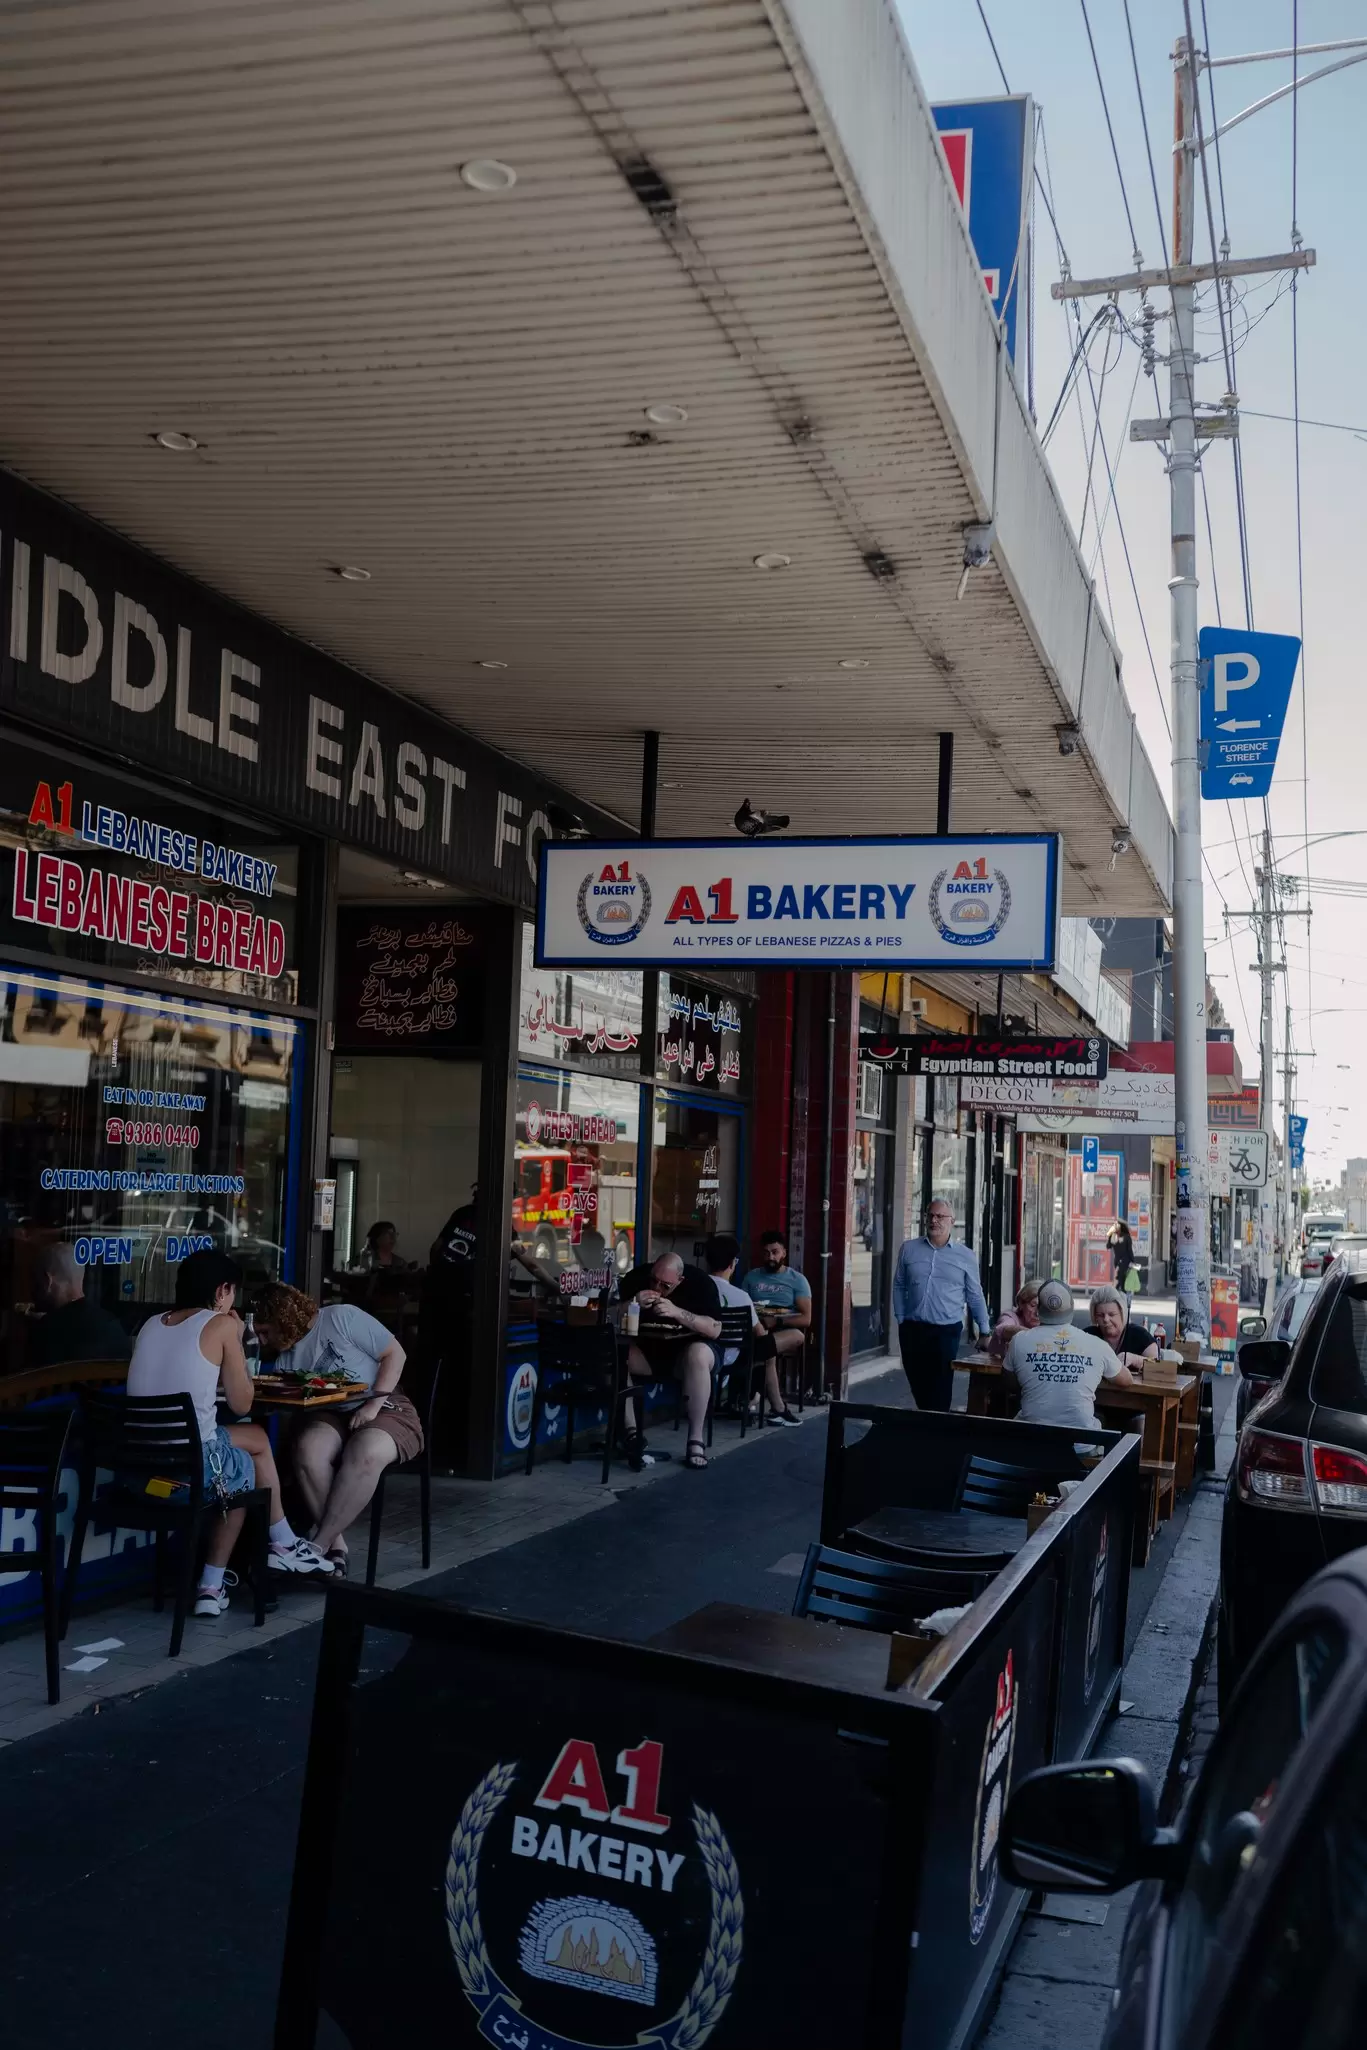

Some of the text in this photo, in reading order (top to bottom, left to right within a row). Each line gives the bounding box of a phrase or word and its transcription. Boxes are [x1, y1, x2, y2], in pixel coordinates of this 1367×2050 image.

[0, 528, 261, 763] IDDLE
[304, 694, 467, 845] EAST
[1214, 652, 1260, 712] P
[1219, 742, 1268, 753] FLORENCE
[1225, 753, 1260, 763] STREET
[27, 780, 76, 837] A1
[80, 800, 197, 874] LEBANESE
[200, 840, 277, 898] BAKERY
[598, 860, 632, 883] A1
[952, 857, 990, 880] A1
[593, 885, 636, 895] BAKERY
[946, 883, 994, 894] BAKERY
[664, 878, 916, 924] A1 BAKERY
[12, 848, 188, 960] LEBANESE
[194, 898, 286, 979] BREAD
[672, 936, 903, 947] ALL TYPES OF LEBANESE PIZZAS & PIES
[1196, 1003, 1204, 1017] 2
[920, 1057, 994, 1074] Egyptian
[997, 1058, 1052, 1075] Street
[1055, 1060, 1098, 1076] Food
[103, 1086, 207, 1111] EAT IN OR TAKE AWAY
[970, 1086, 1034, 1103] DECOR
[996, 1104, 1022, 1115] Wedding
[1032, 1106, 1047, 1116] Party
[1049, 1107, 1083, 1116] Decorations
[124, 1120, 200, 1149] 9386 0440
[543, 1109, 617, 1145] FRESH BREAD
[1086, 1140, 1095, 1152] P
[1244, 1135, 1264, 1145] FOR
[40, 1167, 245, 1194] CATERING FOR LARGE FUNCTIONS
[561, 1192, 597, 1212] DAYS
[74, 1236, 133, 1266] OPEN
[165, 1236, 214, 1264] DAYS
[1025, 1352, 1094, 1367] MACHINA
[1032, 1363, 1085, 1374] MOTOR
[1038, 1373, 1079, 1384] CYCLES
[533, 1738, 671, 1835] A1
[511, 1815, 686, 1893] BAKERY
